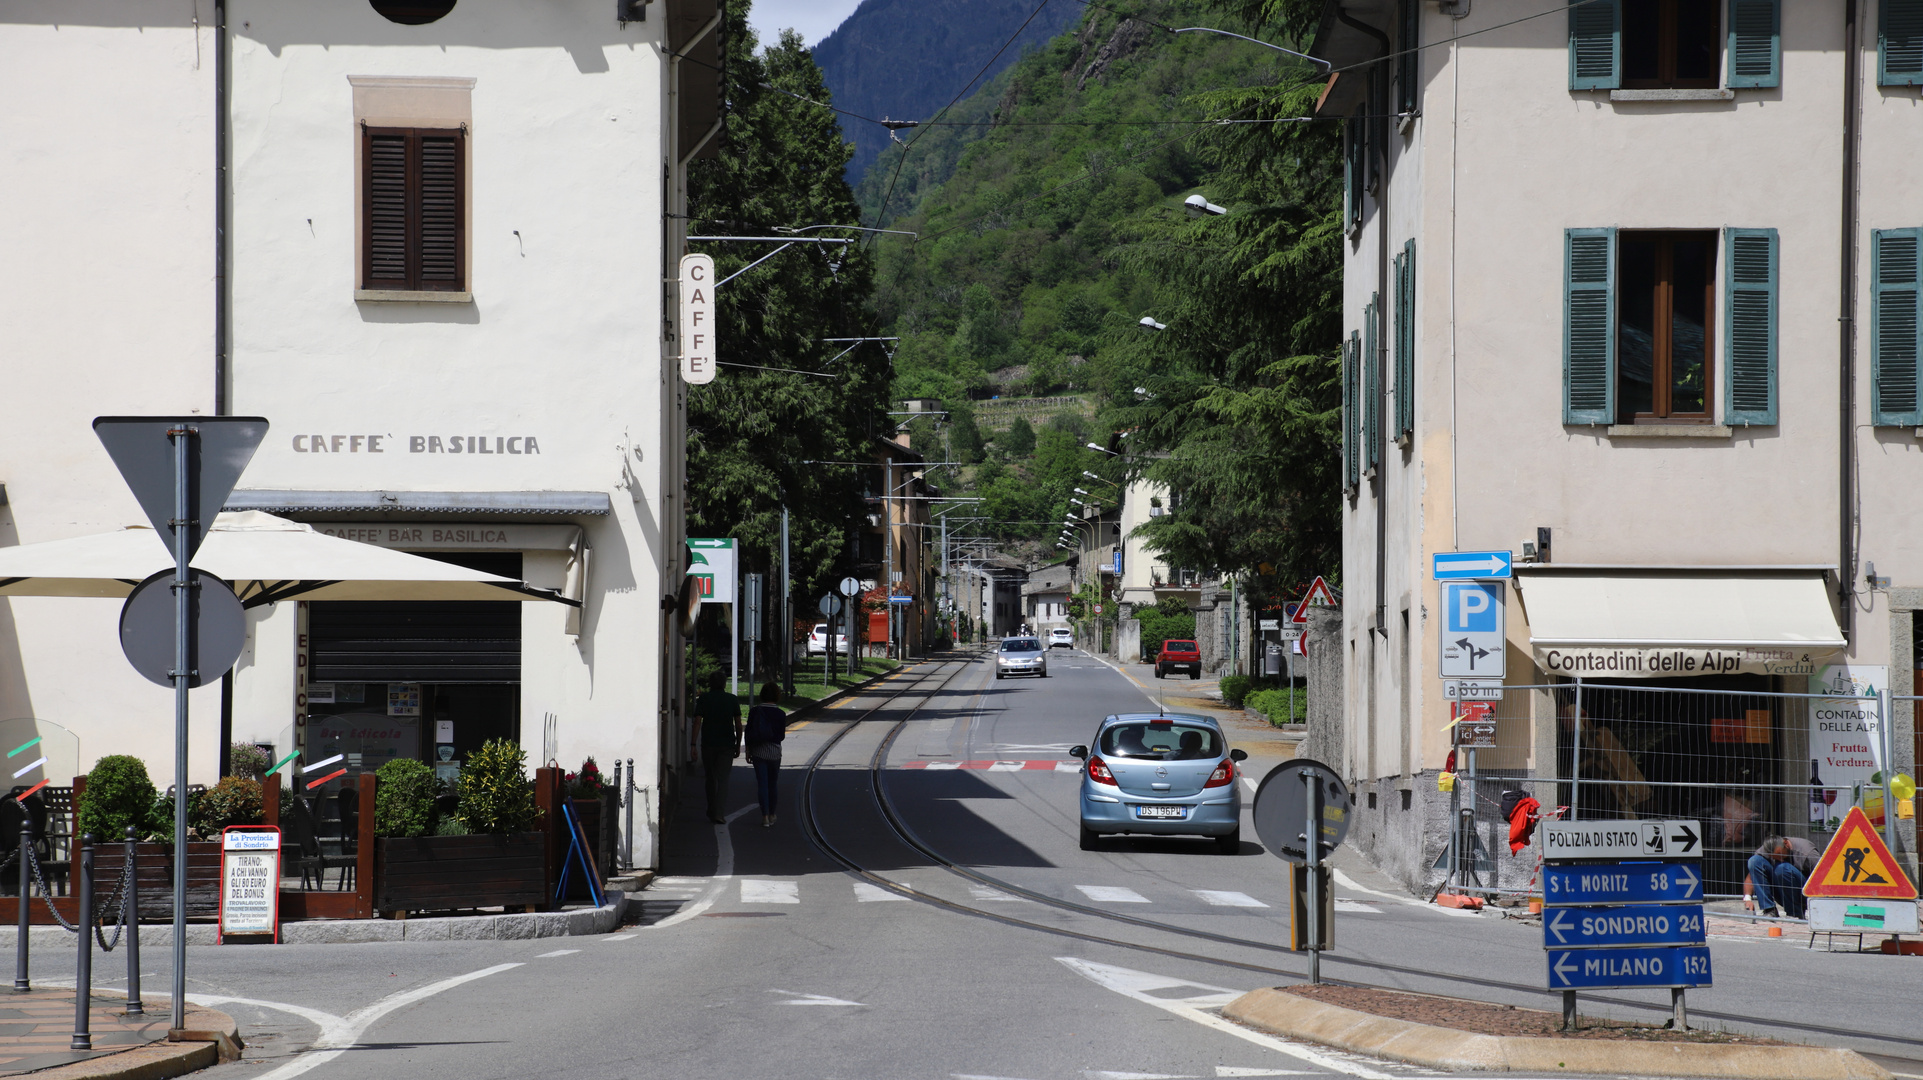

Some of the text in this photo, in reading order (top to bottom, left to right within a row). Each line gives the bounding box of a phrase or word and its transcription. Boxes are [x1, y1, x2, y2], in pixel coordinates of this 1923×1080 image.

[691, 266, 708, 372] CAFFE'
[409, 436, 540, 454] BASILICA
[388, 528, 422, 542] BAR
[432, 529, 507, 542] BASILICA
[1459, 589, 1490, 628] P
[1745, 648, 1810, 662] Frutta &
[1547, 650, 1740, 674] Contadini delle Alpi
[1449, 686, 1455, 696] a
[1816, 710, 1878, 720] CONTADIN
[1820, 722, 1878, 732] DELLE ALPI
[350, 728, 402, 739] Edicola
[1832, 743, 1868, 752] Frutta
[1827, 757, 1874, 767] Verdura
[1549, 831, 1638, 847] POLIZIA DI STATO
[239, 857, 262, 866] TIRANO:
[231, 868, 267, 877] A CHI VANNO
[231, 879, 266, 888] GLI 80 EURO
[1582, 874, 1628, 892] MORITZ
[1650, 874, 1668, 891] 58
[232, 889, 264, 898] DEL BONUS
[1582, 915, 1700, 936] SONDRIO 24
[1585, 956, 1708, 977] MILANO 152
